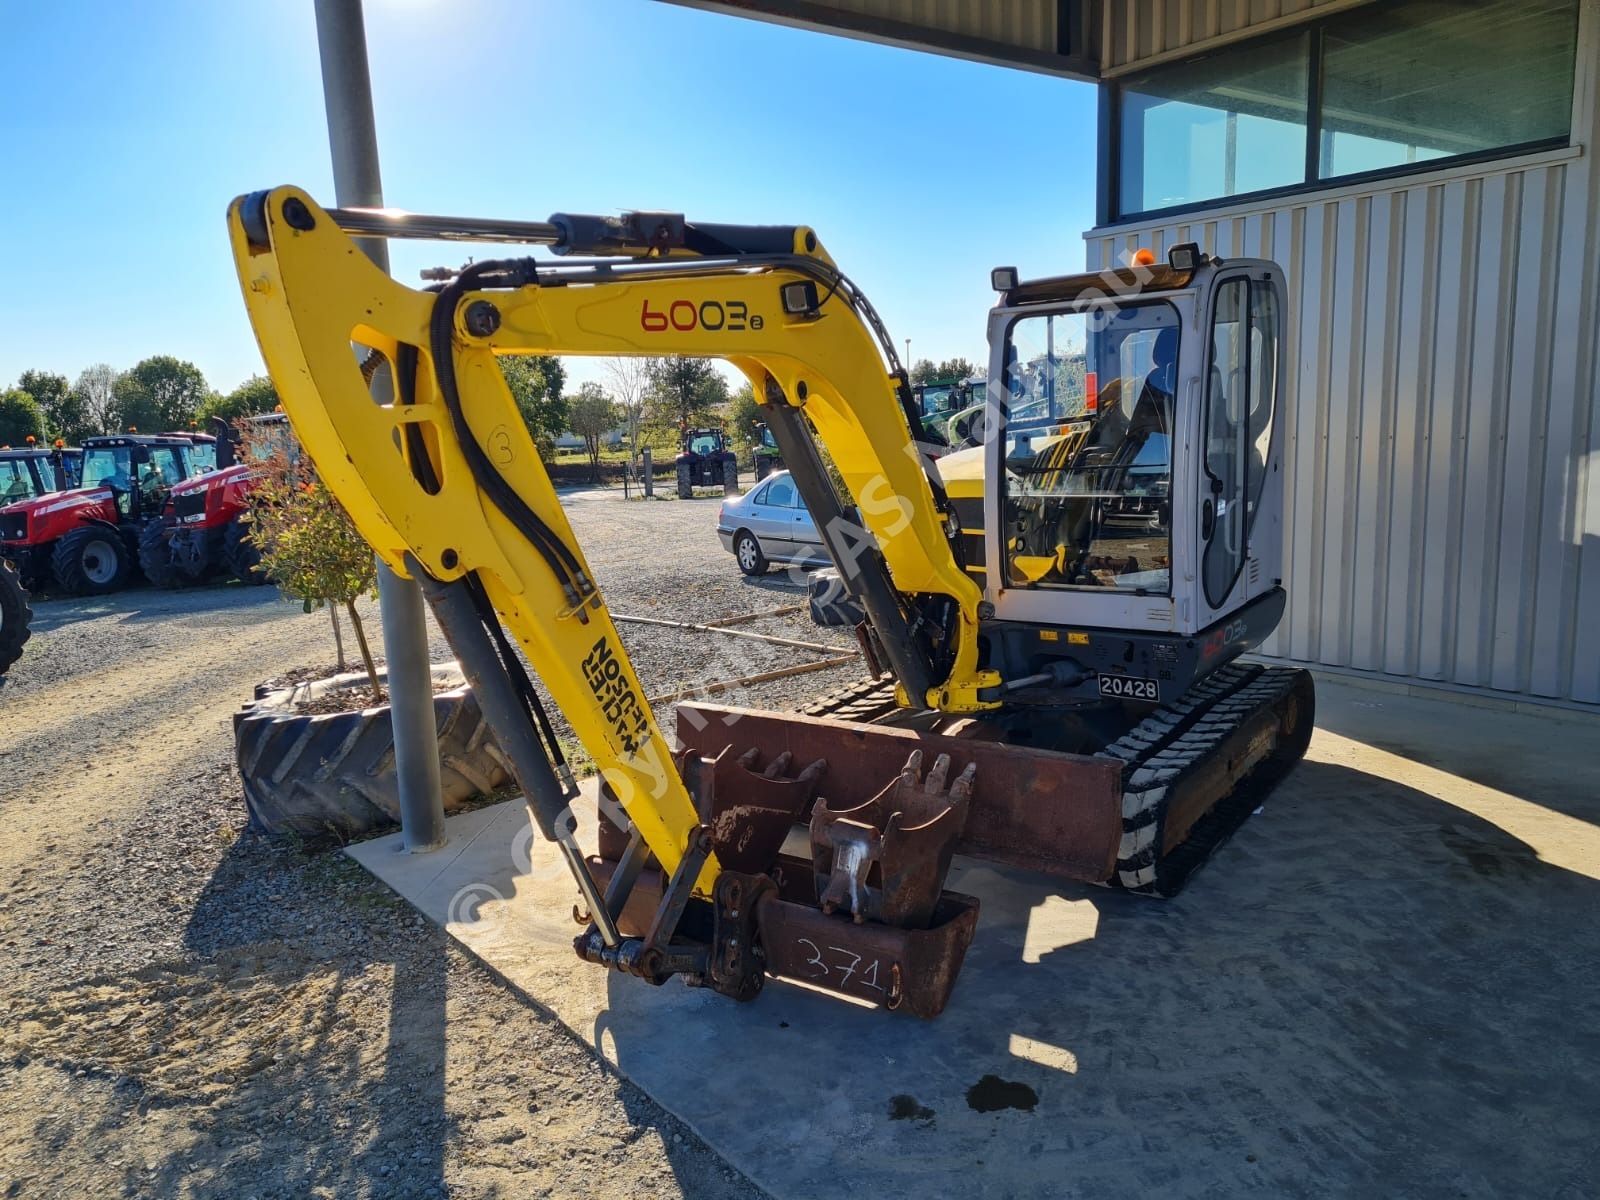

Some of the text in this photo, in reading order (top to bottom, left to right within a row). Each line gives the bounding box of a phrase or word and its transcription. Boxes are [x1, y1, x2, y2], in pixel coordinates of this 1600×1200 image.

[641, 299, 748, 332] 6003
[495, 431, 513, 464] 3
[1101, 677, 1157, 698] 20428
[798, 938, 883, 991] 371
